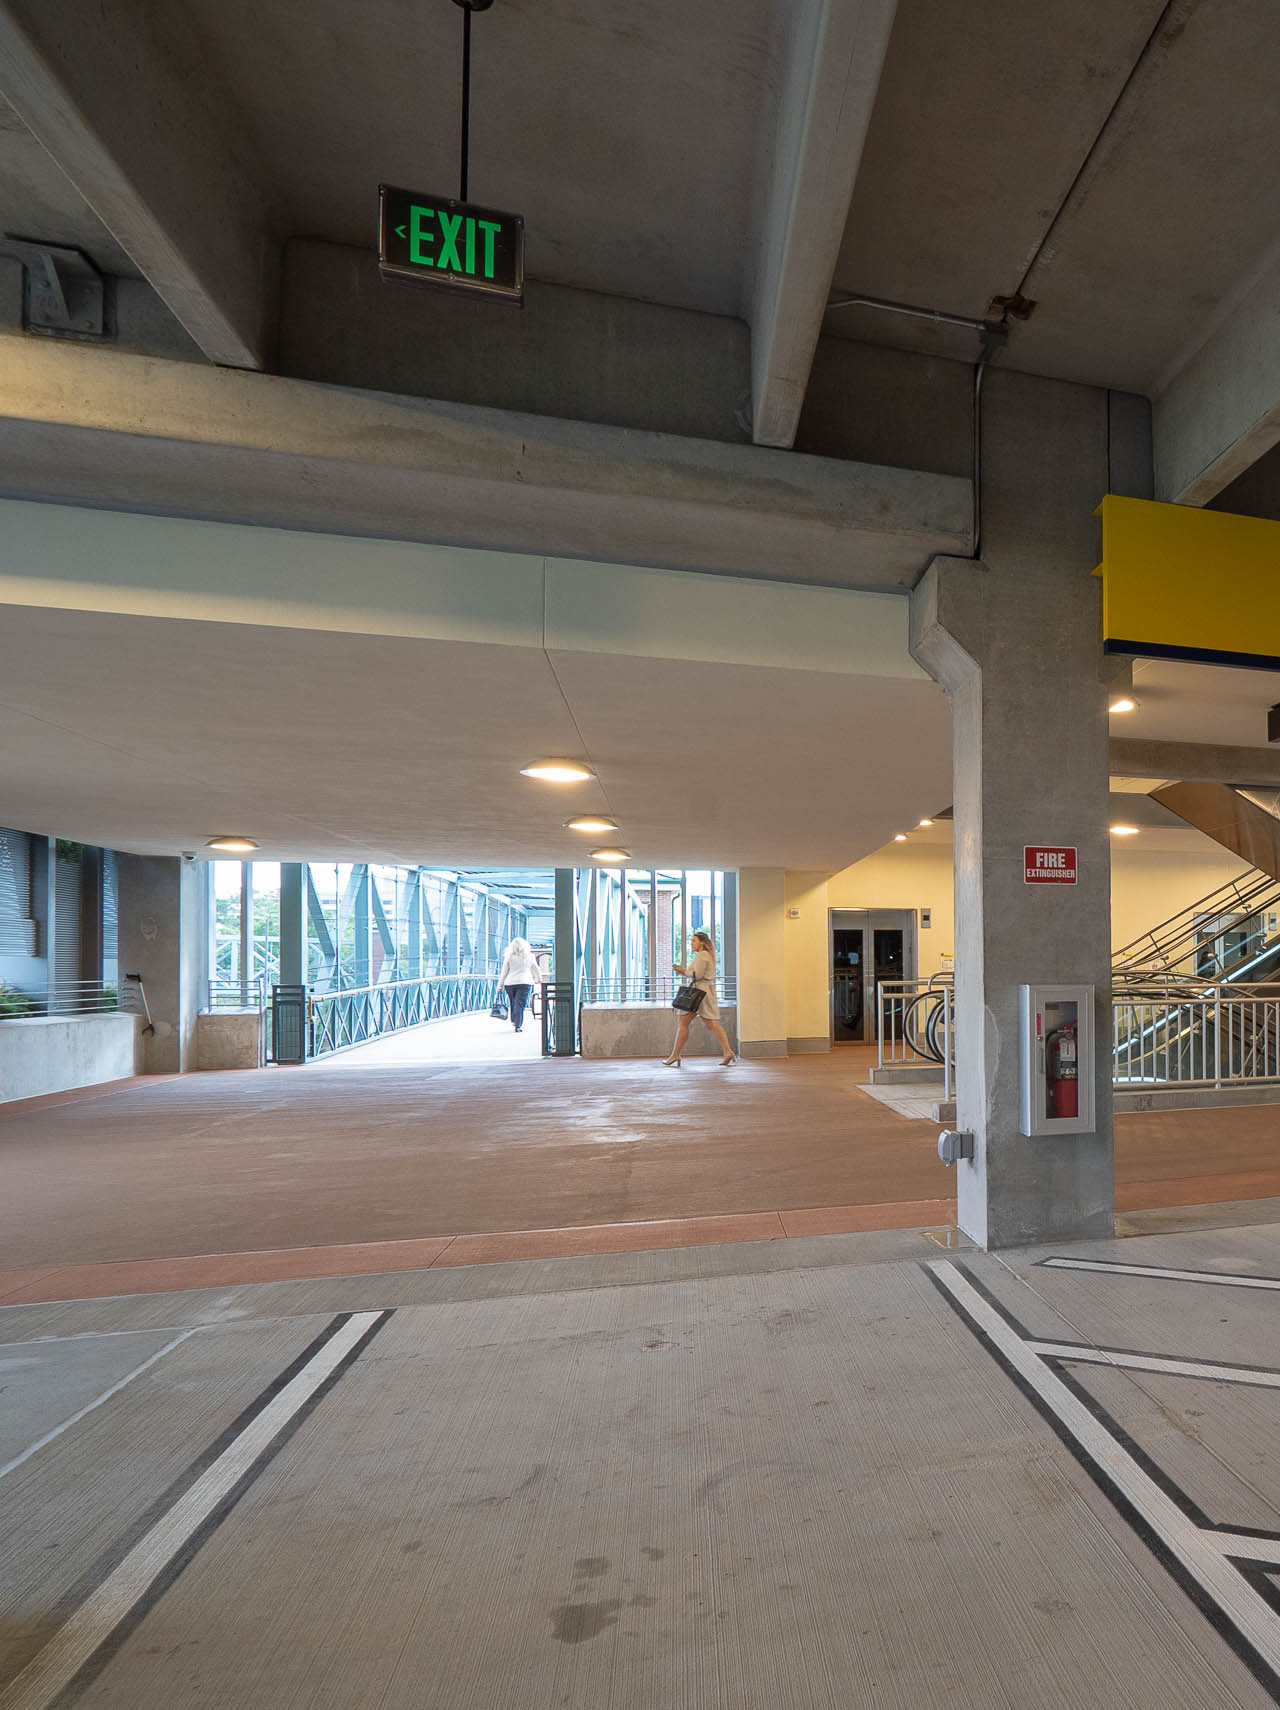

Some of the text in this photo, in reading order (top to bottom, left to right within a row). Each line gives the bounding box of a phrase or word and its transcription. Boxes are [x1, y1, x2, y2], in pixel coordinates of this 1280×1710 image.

[410, 205, 501, 278] EXIT
[1036, 852, 1066, 868] FIRE
[1026, 868, 1075, 879] EXTINGUISHER
